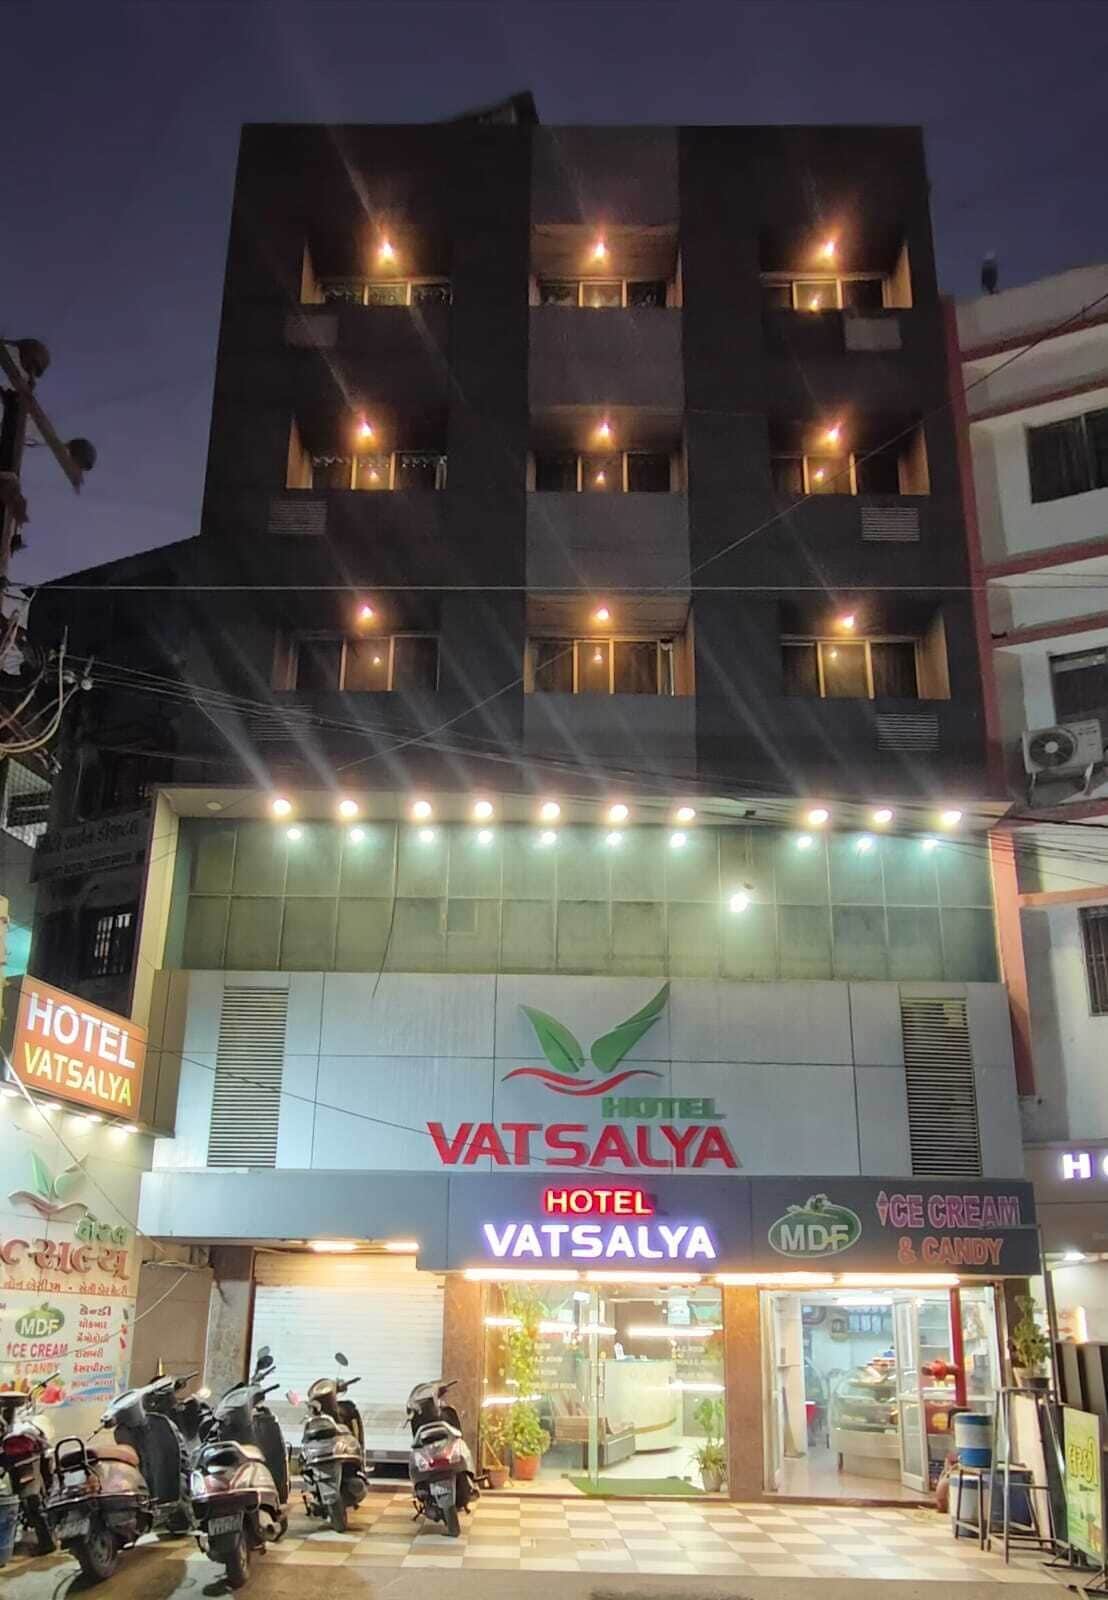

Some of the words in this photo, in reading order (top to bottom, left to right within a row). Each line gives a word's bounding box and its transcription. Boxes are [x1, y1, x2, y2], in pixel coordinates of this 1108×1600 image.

[26, 991, 136, 1070] HOTEL
[24, 1041, 132, 1106] VATSALYA
[602, 1097, 725, 1119] HOTEL
[427, 1122, 742, 1168] VATSALYA
[546, 1190, 652, 1214] HOTEL
[876, 1190, 924, 1228] ICE
[928, 1194, 1021, 1229] CREAM
[484, 1223, 717, 1259] VATSALYA
[779, 1224, 849, 1252] MDF
[898, 1236, 917, 1265] &
[922, 1237, 1004, 1266] CANDY
[20, 1318, 60, 1337] MDF
[6, 1341, 28, 1358] ICE
[30, 1343, 68, 1358] CREAM
